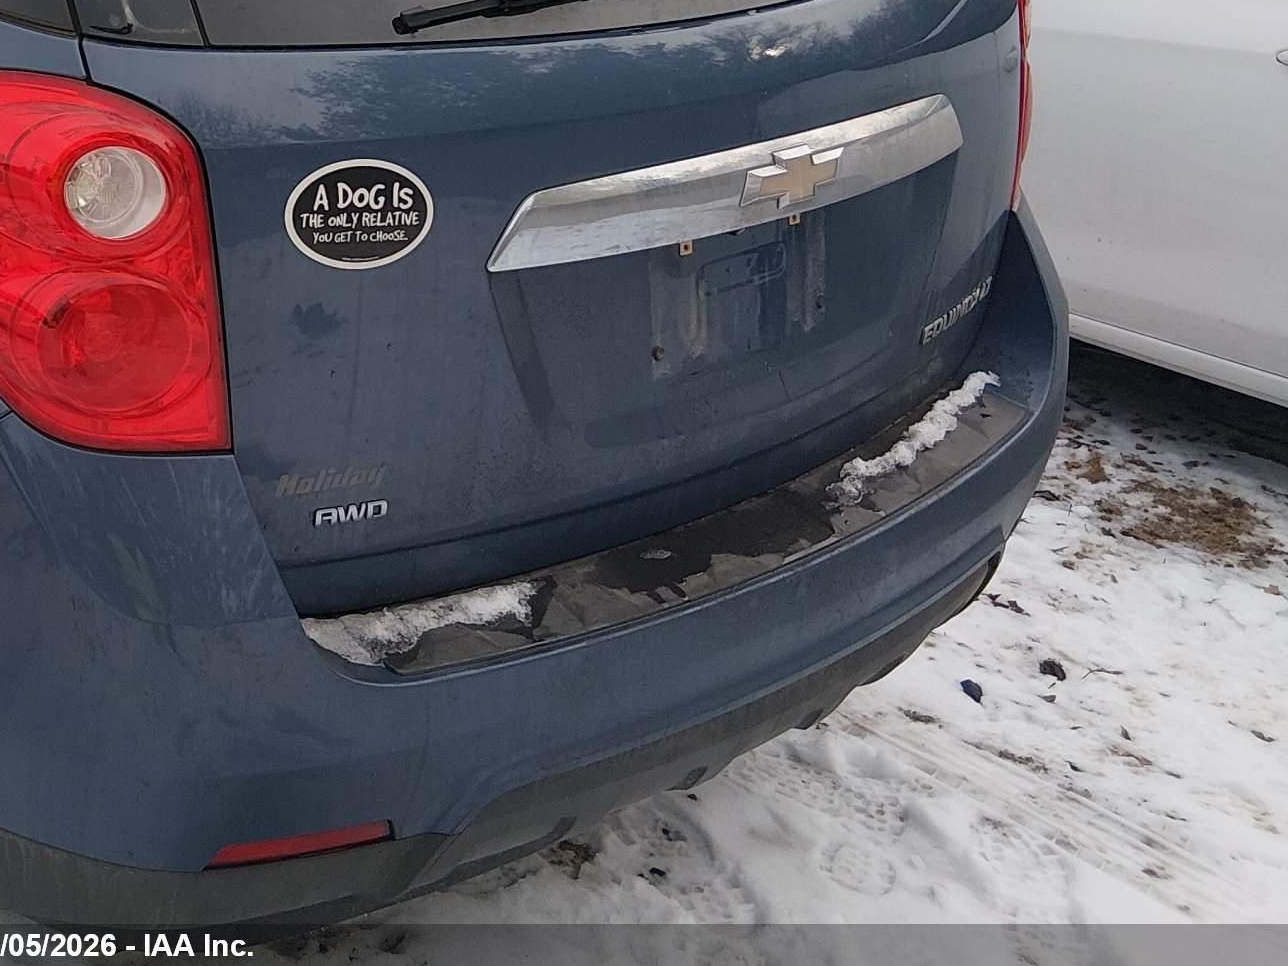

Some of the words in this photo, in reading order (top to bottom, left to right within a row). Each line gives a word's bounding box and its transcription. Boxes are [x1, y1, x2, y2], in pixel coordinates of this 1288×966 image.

[313, 183, 329, 211] A
[300, 213, 325, 229] THE
[362, 210, 420, 227] RELATIVE
[334, 231, 354, 243] GET
[920, 281, 982, 345] EQUINOX
[314, 500, 388, 527] AWD
